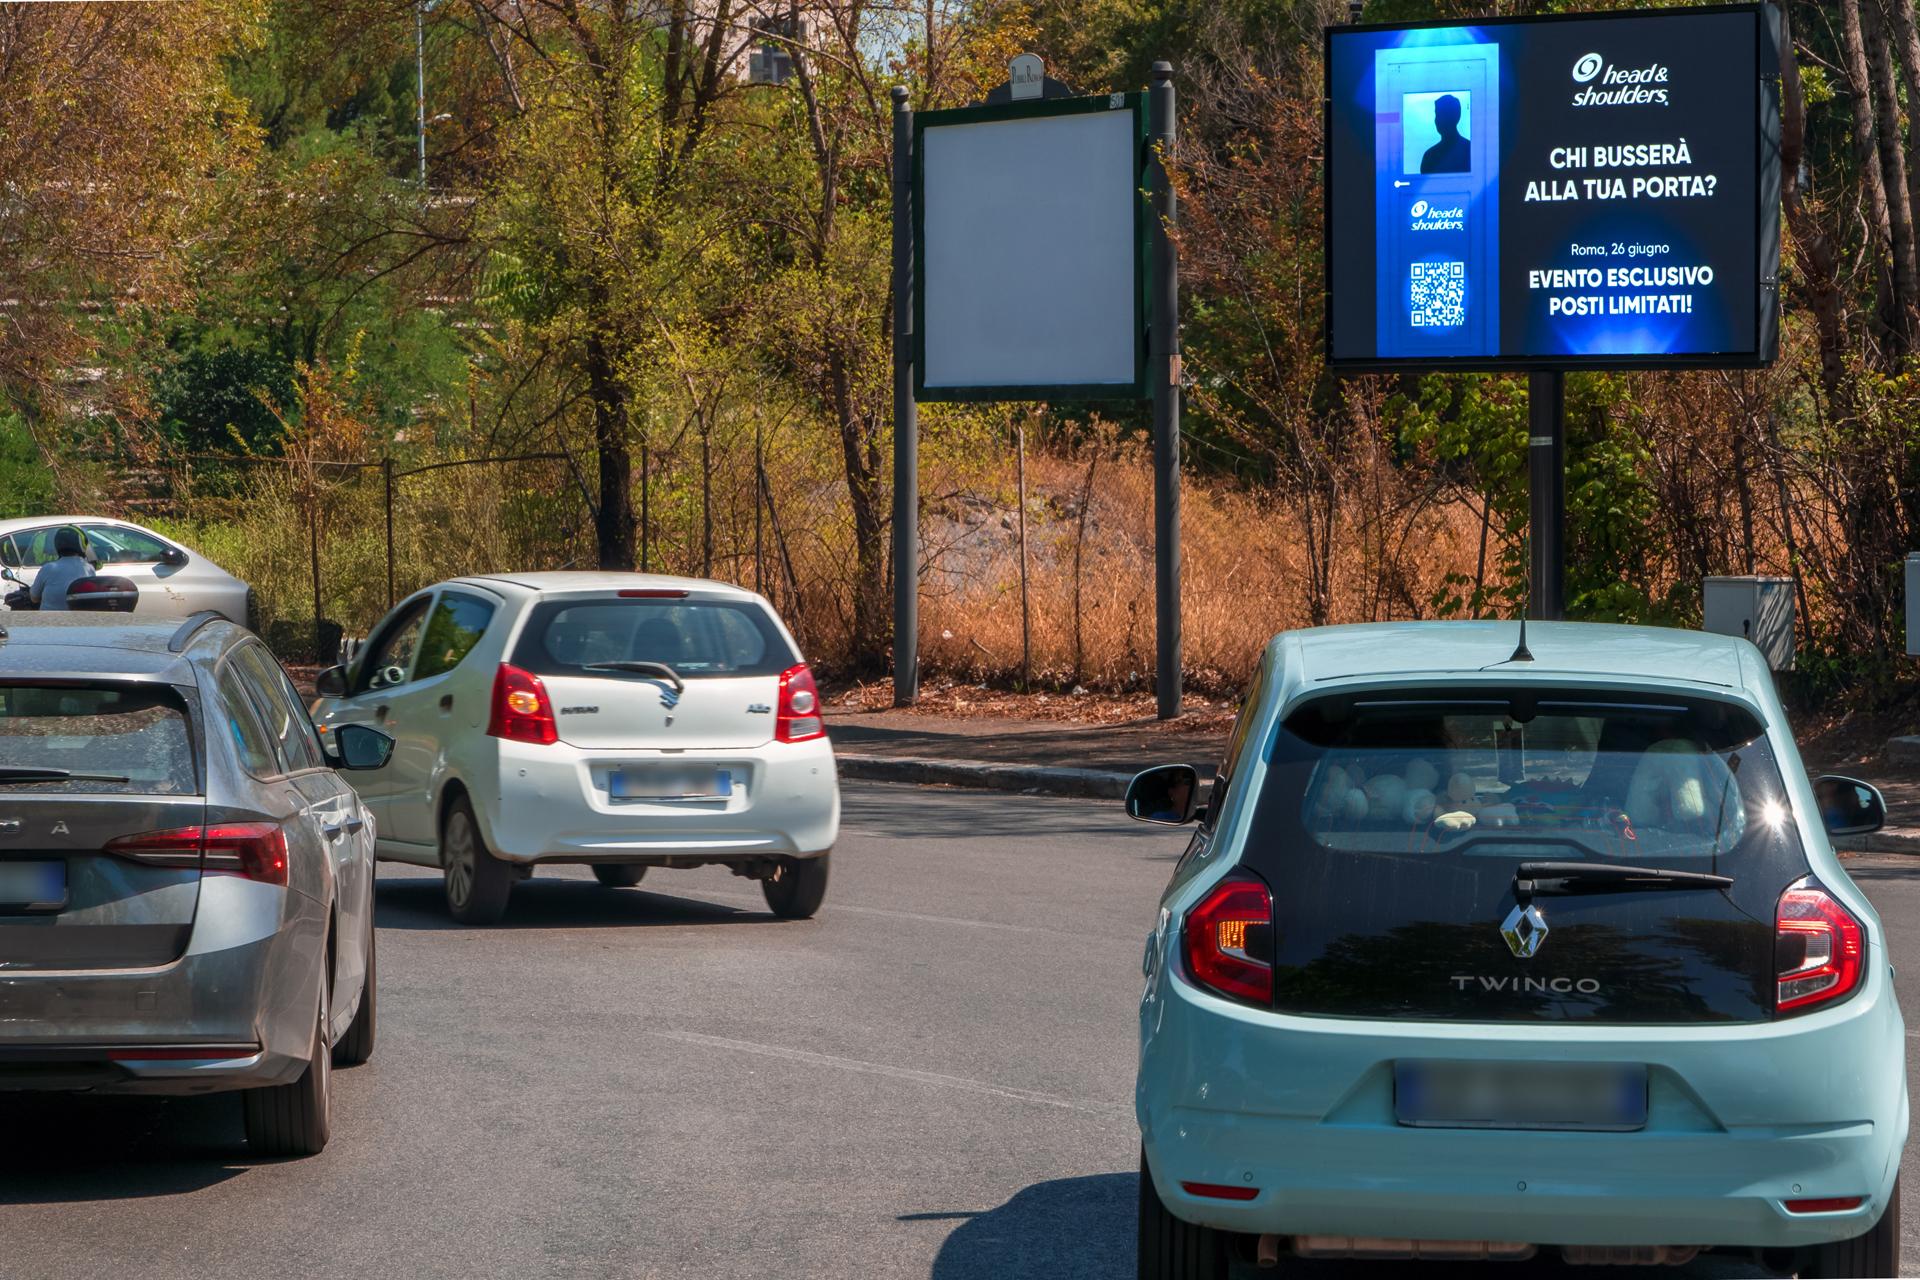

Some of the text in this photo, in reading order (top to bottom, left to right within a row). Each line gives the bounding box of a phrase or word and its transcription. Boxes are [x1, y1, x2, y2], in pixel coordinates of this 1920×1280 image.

[1550, 138, 1692, 169] CHI BUSSERÀ
[1524, 175, 1717, 201] ALLA TUA PORTA?
[1571, 242, 1670, 258] Roma, 26 giugno
[1529, 265, 1714, 289] EVENTO ESCLUSIVO
[1550, 295, 1692, 316] POSTI LIMITATI!
[1450, 976, 1601, 993] TWINGO
